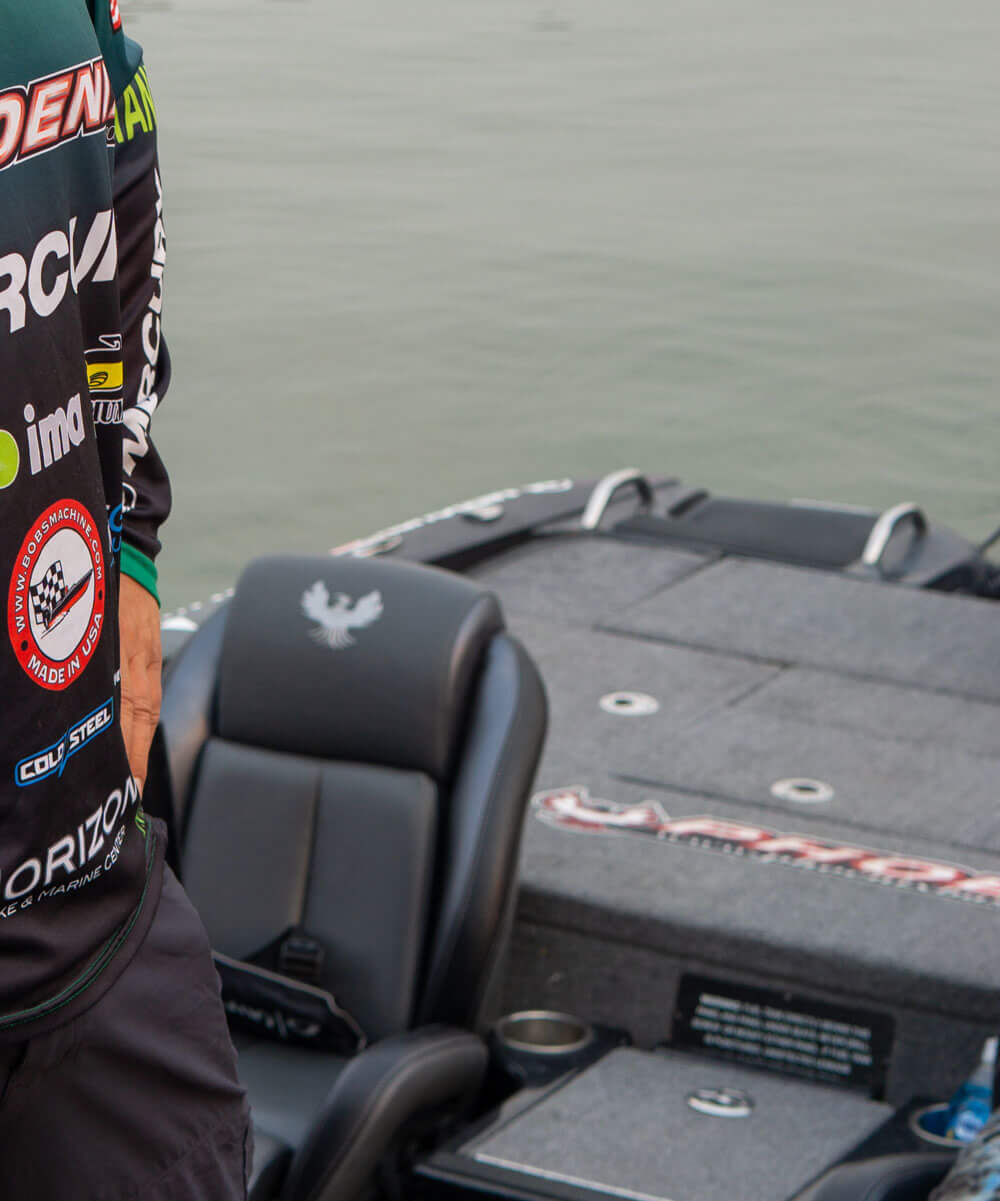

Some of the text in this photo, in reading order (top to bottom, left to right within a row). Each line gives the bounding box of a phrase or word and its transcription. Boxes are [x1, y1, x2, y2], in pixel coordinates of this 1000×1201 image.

[23, 391, 86, 476] ima
[15, 507, 103, 633] WWW.BOBSMACHINE.COM
[27, 654, 66, 685] MADE
[67, 655, 82, 679] IN
[81, 612, 103, 657] USA
[20, 707, 112, 781] COLD STEEL
[20, 896, 34, 909] &
[37, 864, 103, 901] MARINE
[103, 823, 127, 872] CENTER
